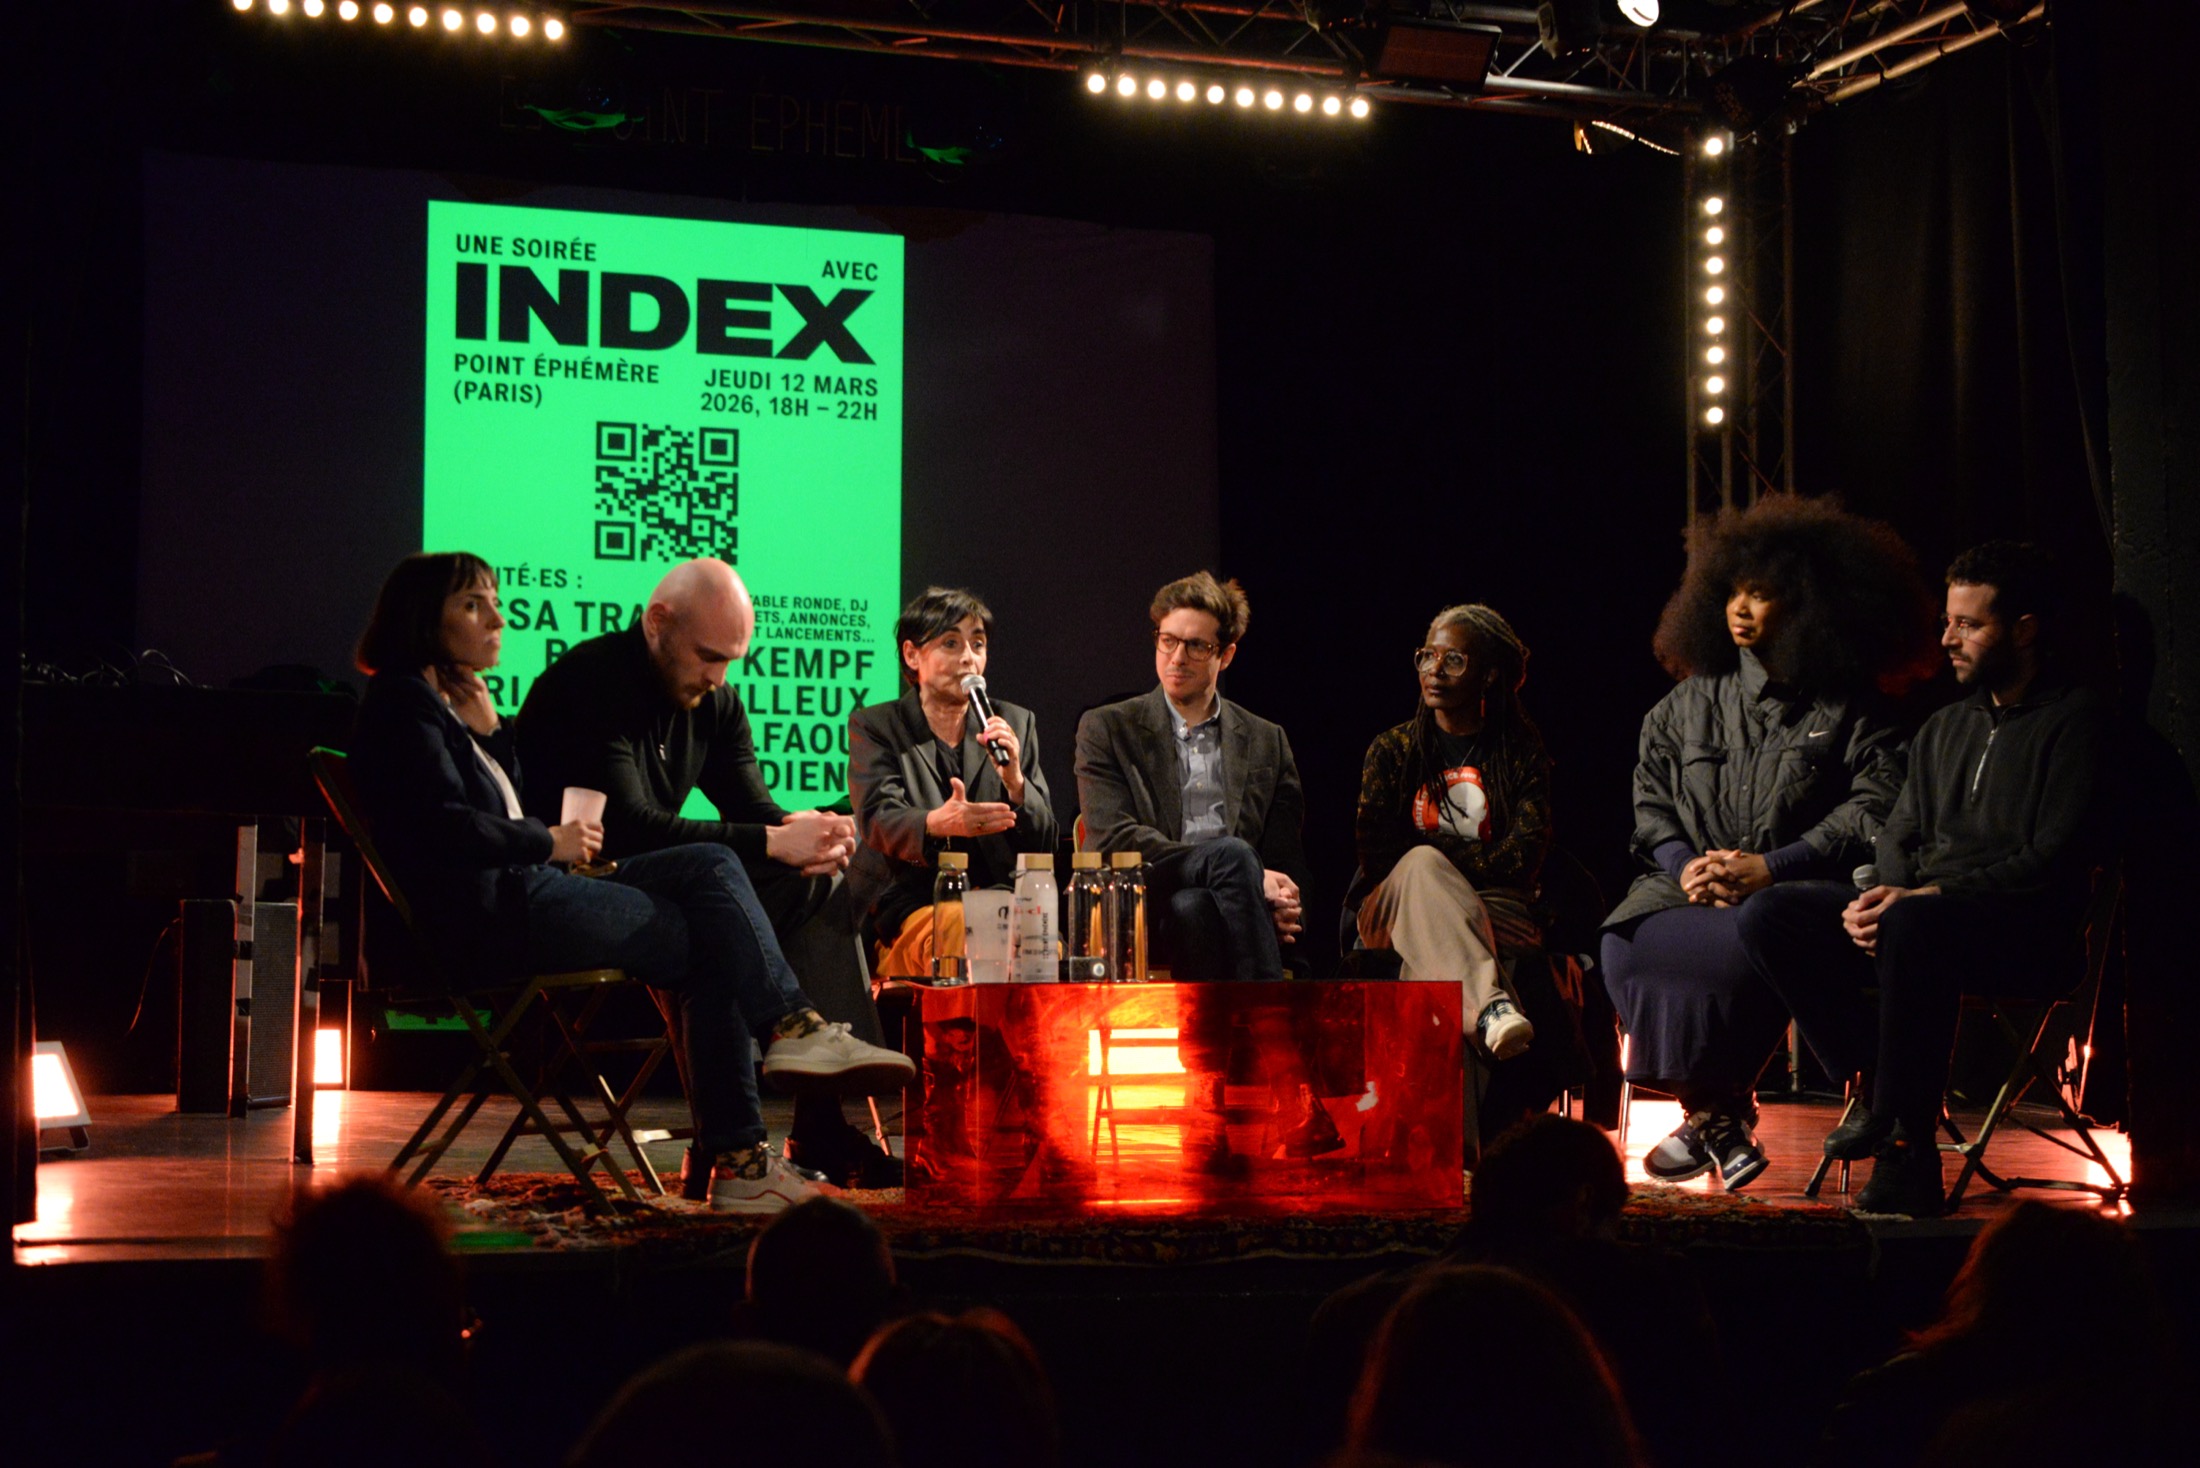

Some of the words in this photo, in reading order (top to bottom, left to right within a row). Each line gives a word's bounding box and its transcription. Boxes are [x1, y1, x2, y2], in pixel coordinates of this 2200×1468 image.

[611, 86, 724, 144] INT
[456, 233, 503, 255] UNE
[512, 237, 596, 262] SOIRÉE
[821, 260, 878, 282] AVEC
[455, 261, 877, 366] INDEX
[454, 353, 525, 376] POINT
[534, 353, 659, 384] ÉPHÉMÈRE
[704, 368, 771, 390] JEUDI
[781, 373, 805, 392] 12
[814, 375, 878, 397] MARS
[453, 380, 542, 408] (PARIS)
[701, 392, 760, 416] 2026,
[769, 396, 809, 417] 18H
[837, 400, 877, 421] 22H
[496, 562, 569, 589] ITÉ·ES
[500, 598, 560, 634] SA
[573, 600, 647, 634] TRA
[793, 596, 845, 611] RONDE,
[850, 599, 868, 612] DJ
[755, 610, 785, 625] ETS,
[789, 612, 871, 629] ANNONCES,
[766, 626, 875, 643] LANCEMENTS...
[743, 646, 875, 681] KEMPF
[757, 758, 846, 793] DIEN
